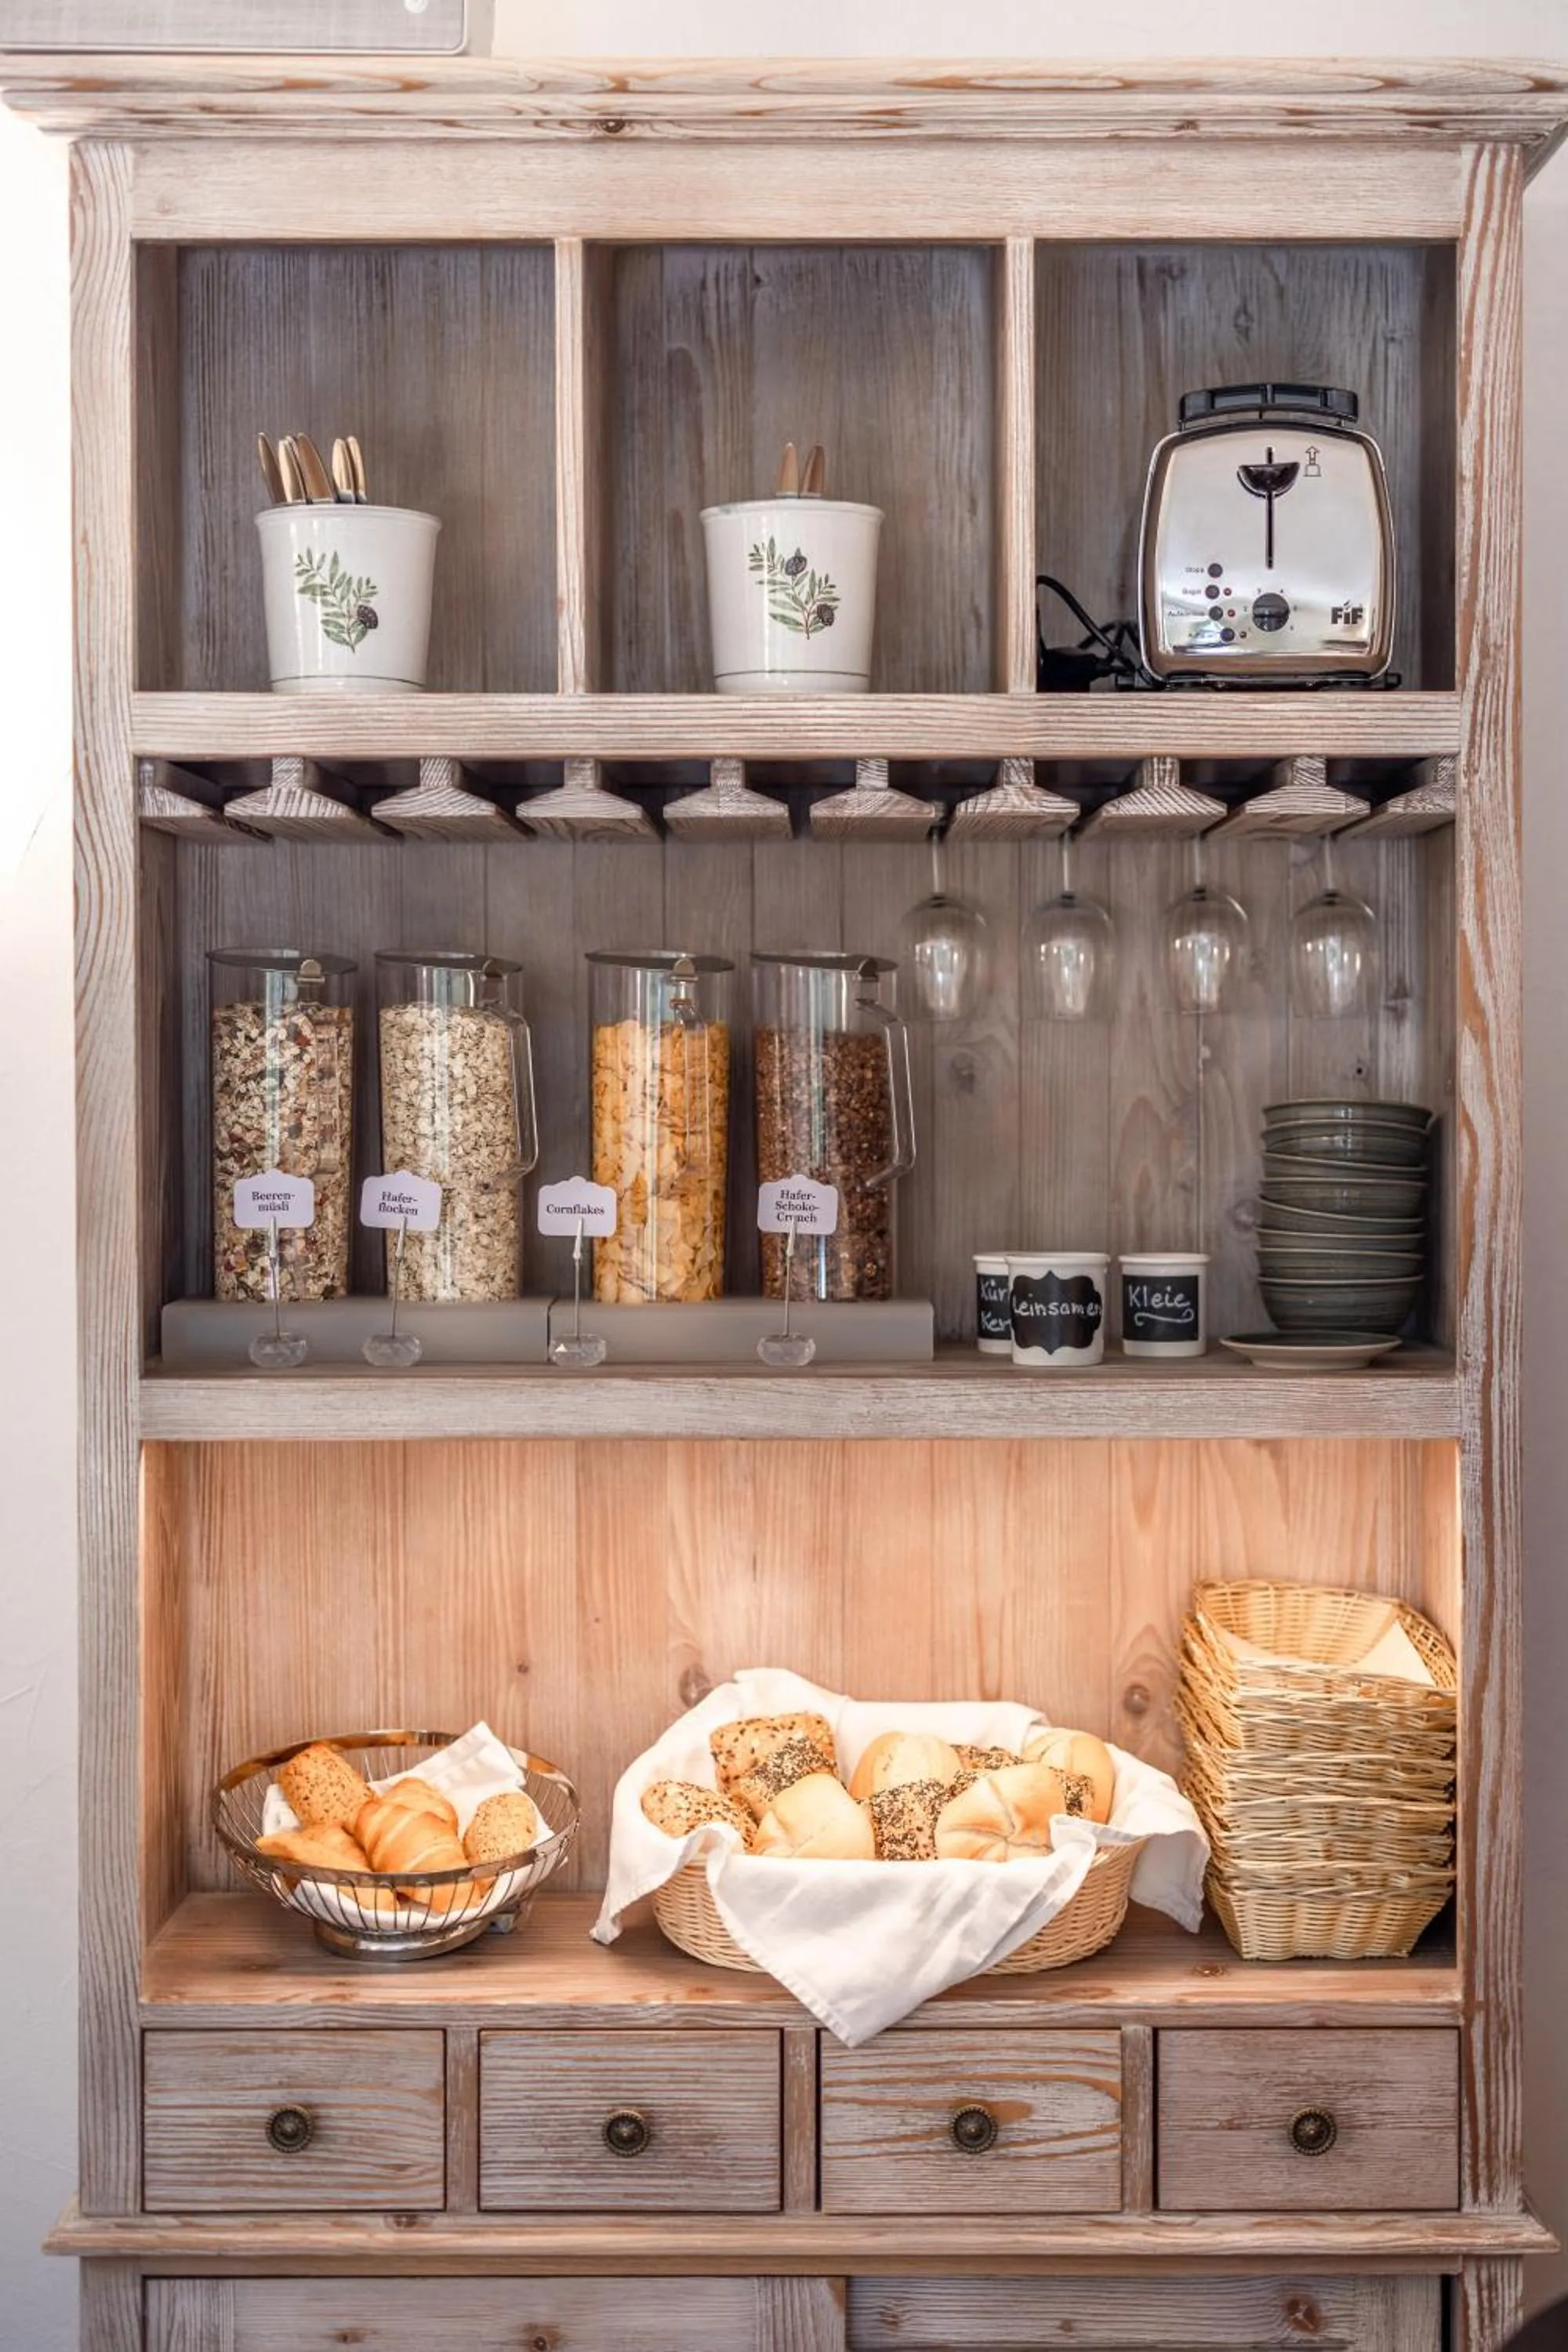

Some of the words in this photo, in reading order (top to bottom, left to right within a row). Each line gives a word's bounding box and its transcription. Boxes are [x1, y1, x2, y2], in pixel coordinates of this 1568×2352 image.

[252, 1191, 296, 1201] Beeren-
[382, 1191, 418, 1203] Hafer-
[780, 1189, 816, 1200] Hafer-
[258, 1203, 289, 1212] müsli
[378, 1203, 419, 1216] flocken
[546, 1203, 605, 1215] Cornflakes
[775, 1200, 820, 1211] Schoko-
[981, 1279, 1010, 1301] Kür
[1128, 1285, 1190, 1309] Kleie
[981, 1310, 1011, 1331] Ker
